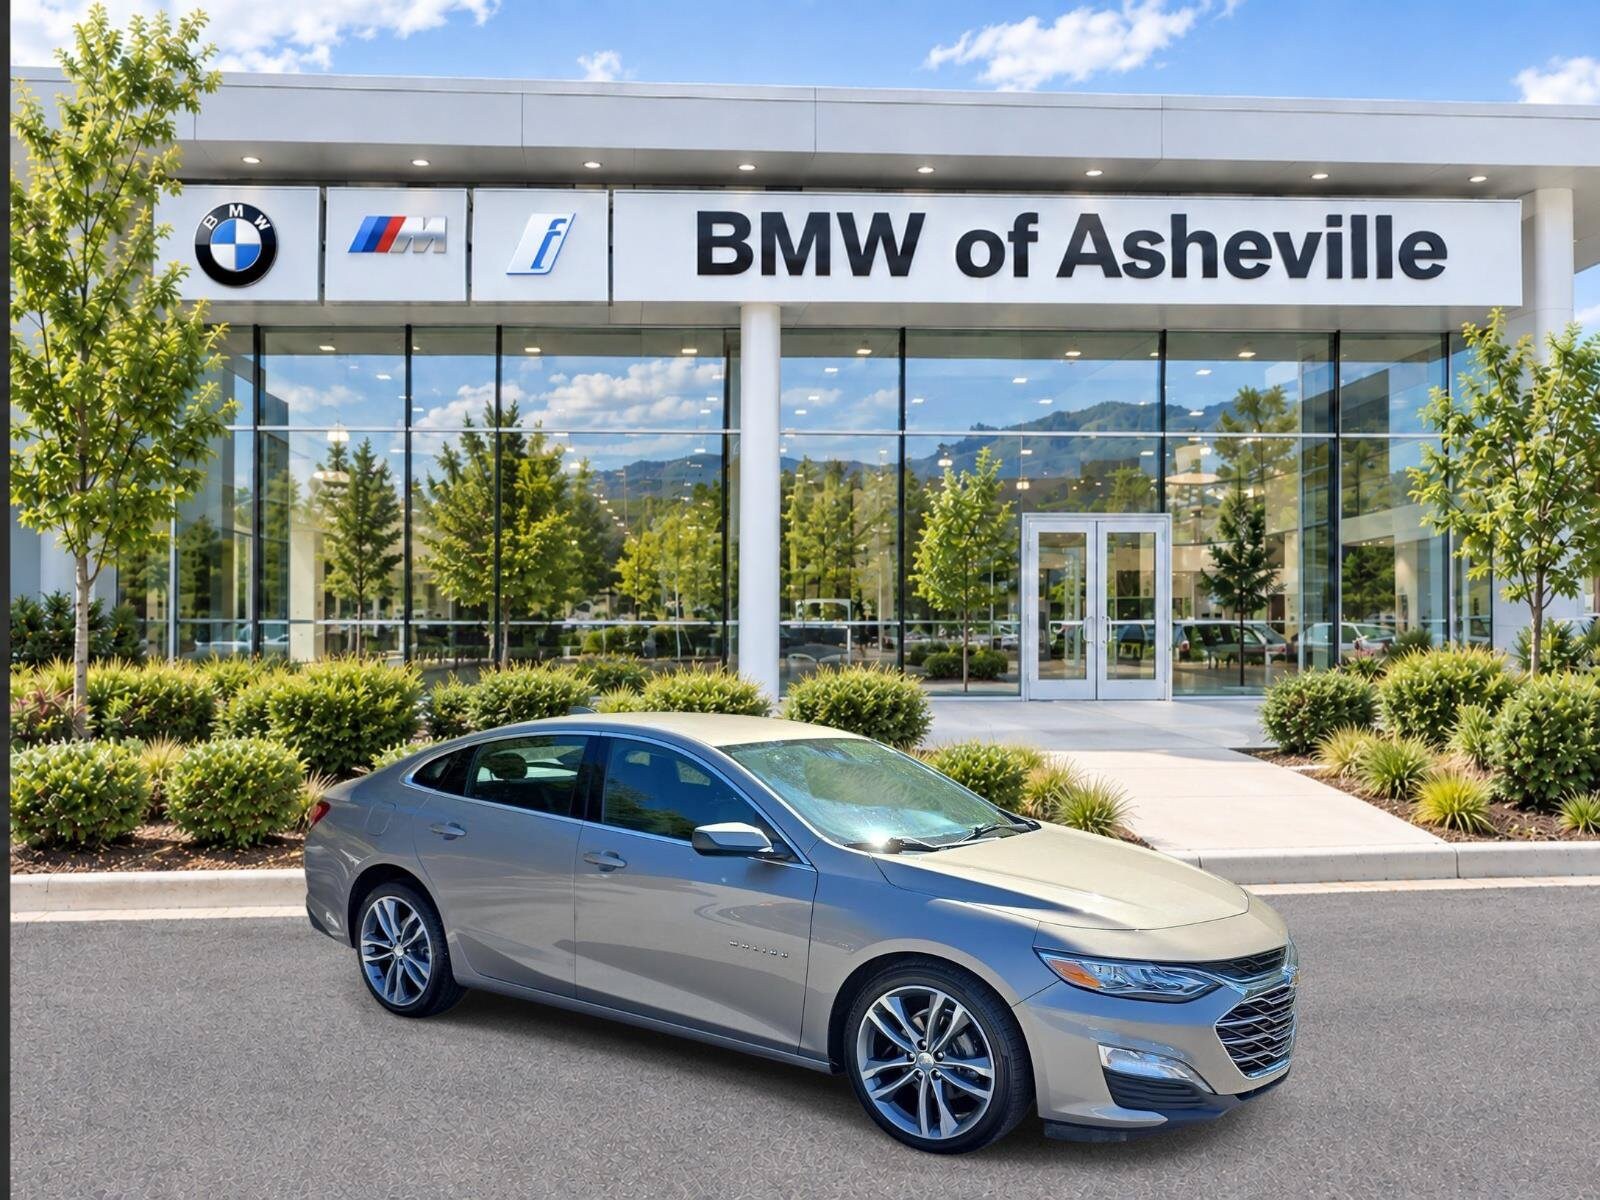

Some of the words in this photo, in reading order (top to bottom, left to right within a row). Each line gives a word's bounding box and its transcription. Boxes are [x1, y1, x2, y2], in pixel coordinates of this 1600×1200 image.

[202, 203, 271, 231] BMW
[697, 210, 926, 277] BMW
[955, 212, 1039, 278] of
[1056, 213, 1449, 280] Asheville
